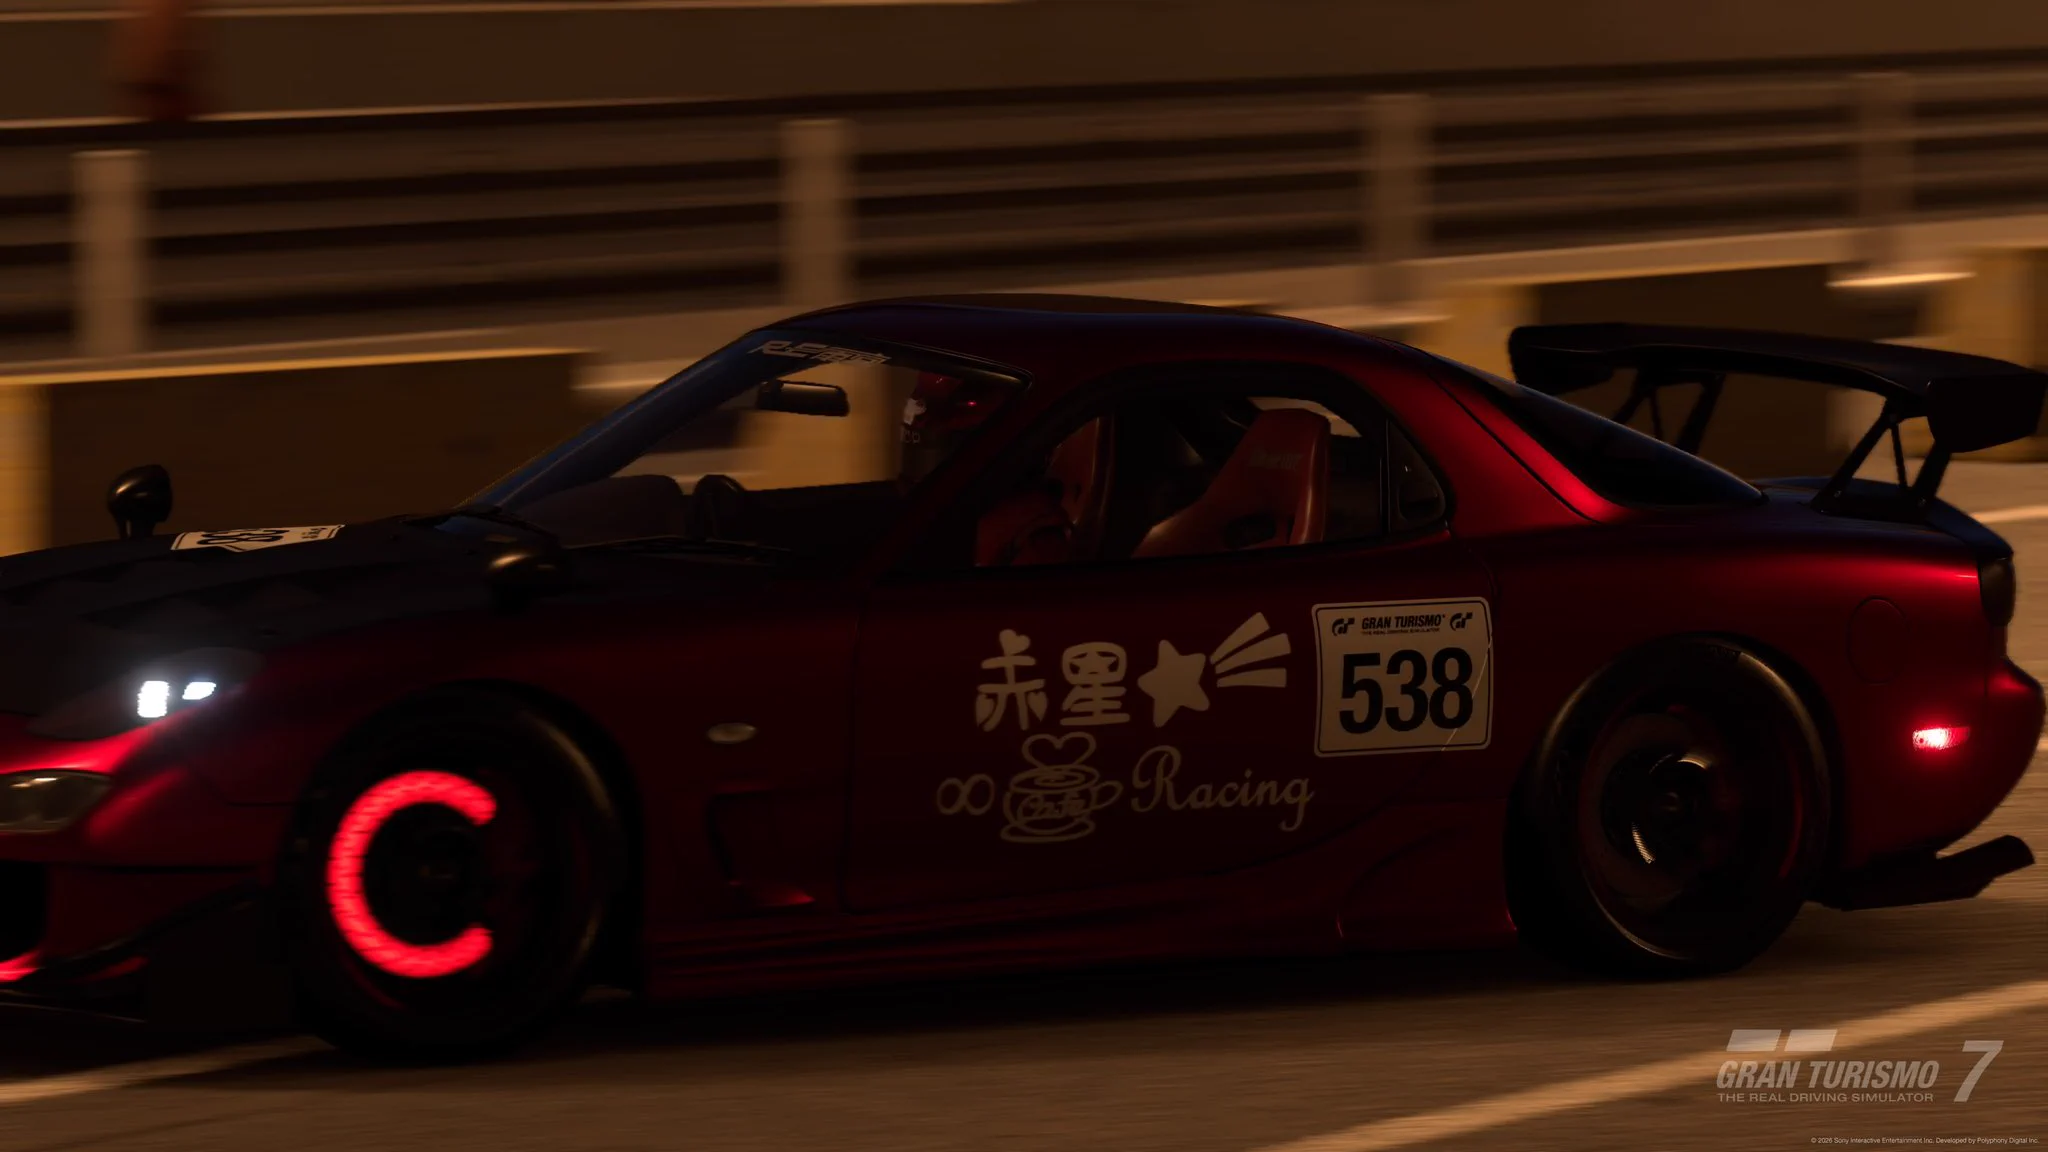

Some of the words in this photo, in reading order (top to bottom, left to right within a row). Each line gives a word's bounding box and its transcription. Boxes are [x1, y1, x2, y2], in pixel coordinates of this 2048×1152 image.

[1362, 617, 1391, 630] GRAN
[1394, 614, 1442, 628] TURISMO
[1339, 647, 1473, 734] 538
[1130, 745, 1314, 832] Racing
